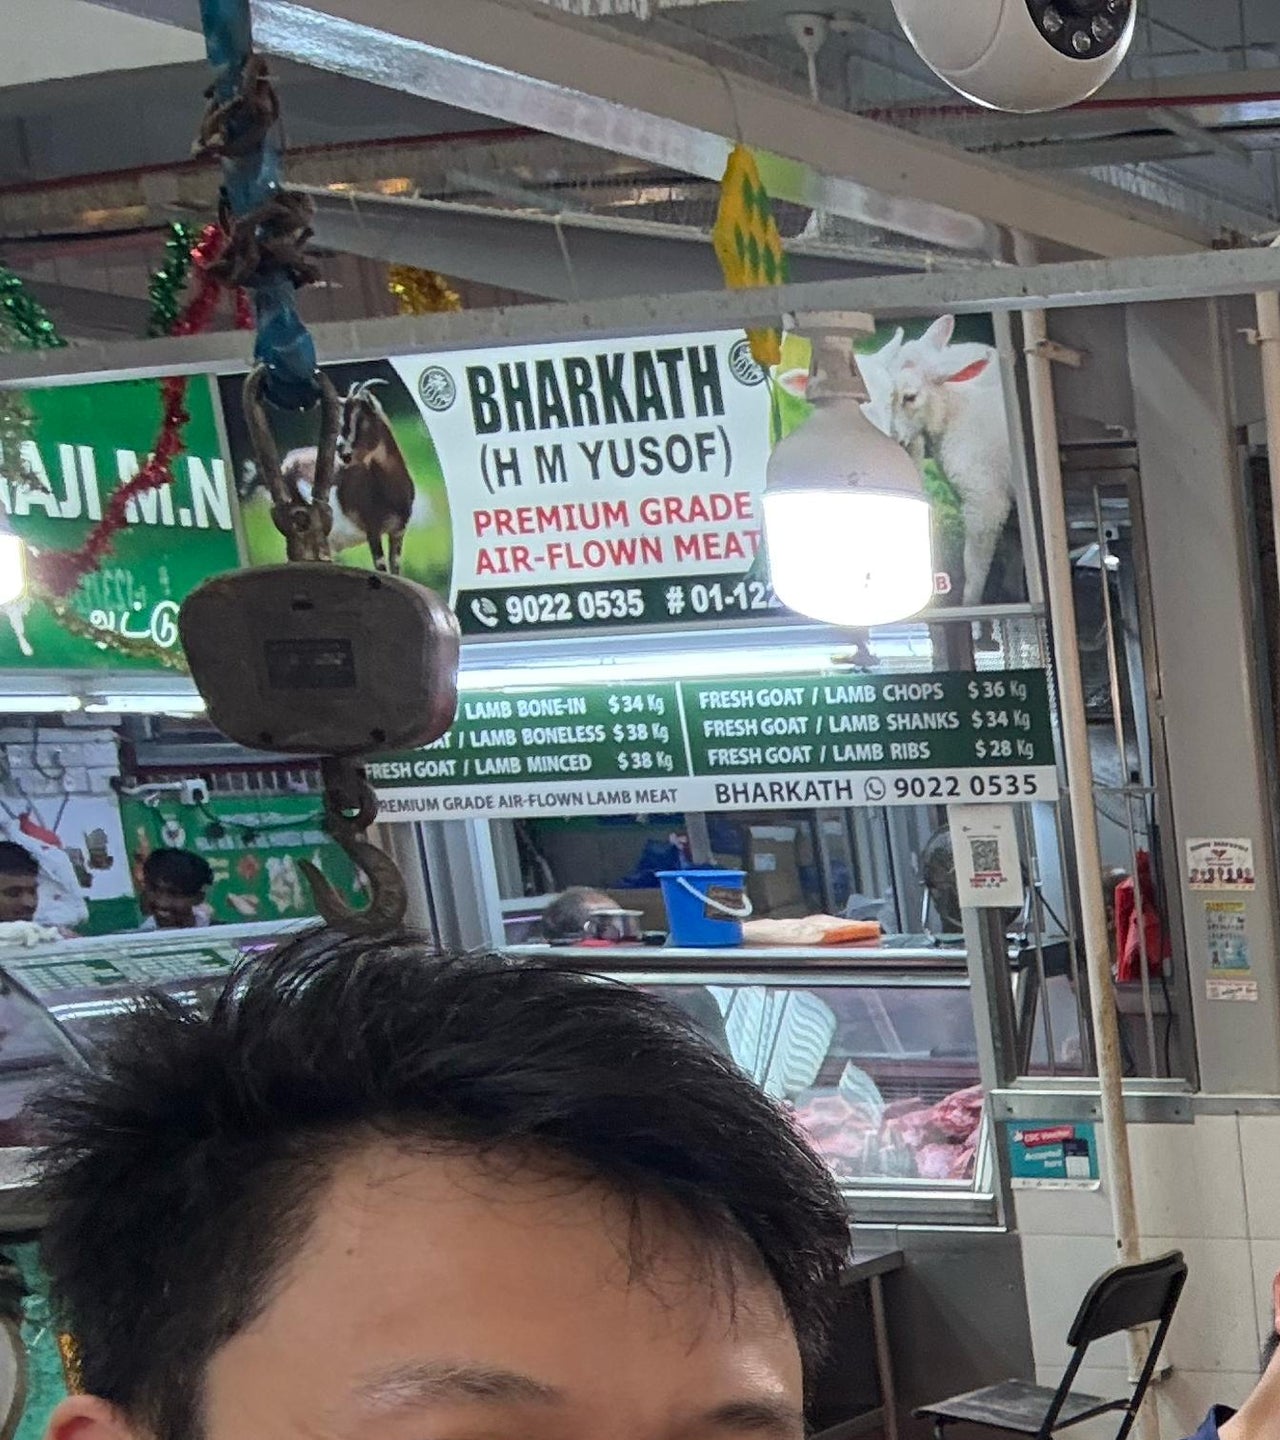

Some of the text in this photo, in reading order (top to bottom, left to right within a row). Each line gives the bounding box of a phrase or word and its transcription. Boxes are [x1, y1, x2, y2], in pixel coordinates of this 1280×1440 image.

[466, 344, 725, 435] BHARKATH
[479, 425, 732, 494] (H M YUSOF)
[473, 491, 754, 537] PREMIUM GRADE
[475, 530, 762, 575] AIR-FLOWN MEAT
[506, 591, 572, 624] 9022
[578, 589, 645, 619] 0535
[465, 701, 511, 720] LAMB
[516, 697, 586, 717] BONE-IN
[647, 693, 664, 715] Kg
[699, 689, 754, 709] FRESH
[759, 687, 805, 707] GOAT
[824, 685, 876, 704] LAMB
[883, 681, 944, 702] CHOPS
[1010, 680, 1027, 702] Kg
[470, 728, 517, 747] LAMB
[521, 724, 606, 745] BONELESS
[652, 722, 669, 744] Kg
[703, 718, 758, 738] FRESH
[761, 716, 808, 736] GOAT
[828, 714, 880, 733] LAMB
[886, 711, 959, 731] SHANKS
[1013, 709, 1030, 731] Kg
[364, 761, 411, 780] FRESH
[414, 759, 456, 778] GOAT
[474, 756, 521, 775] LAMB
[527, 753, 592, 773] MINCED
[656, 750, 673, 772] Kg
[708, 747, 761, 767] FRESH
[765, 745, 813, 765] GOAT
[832, 743, 884, 762] LAMB
[891, 741, 931, 760] RIBS
[1017, 738, 1034, 760] Kg
[443, 794, 494, 811] GRADE
[498, 792, 583, 808] AIR-FLOWN
[586, 790, 632, 806] LAMB
[636, 788, 678, 804] MEAT
[715, 774, 1037, 803] BHARKATH 9022 0535
